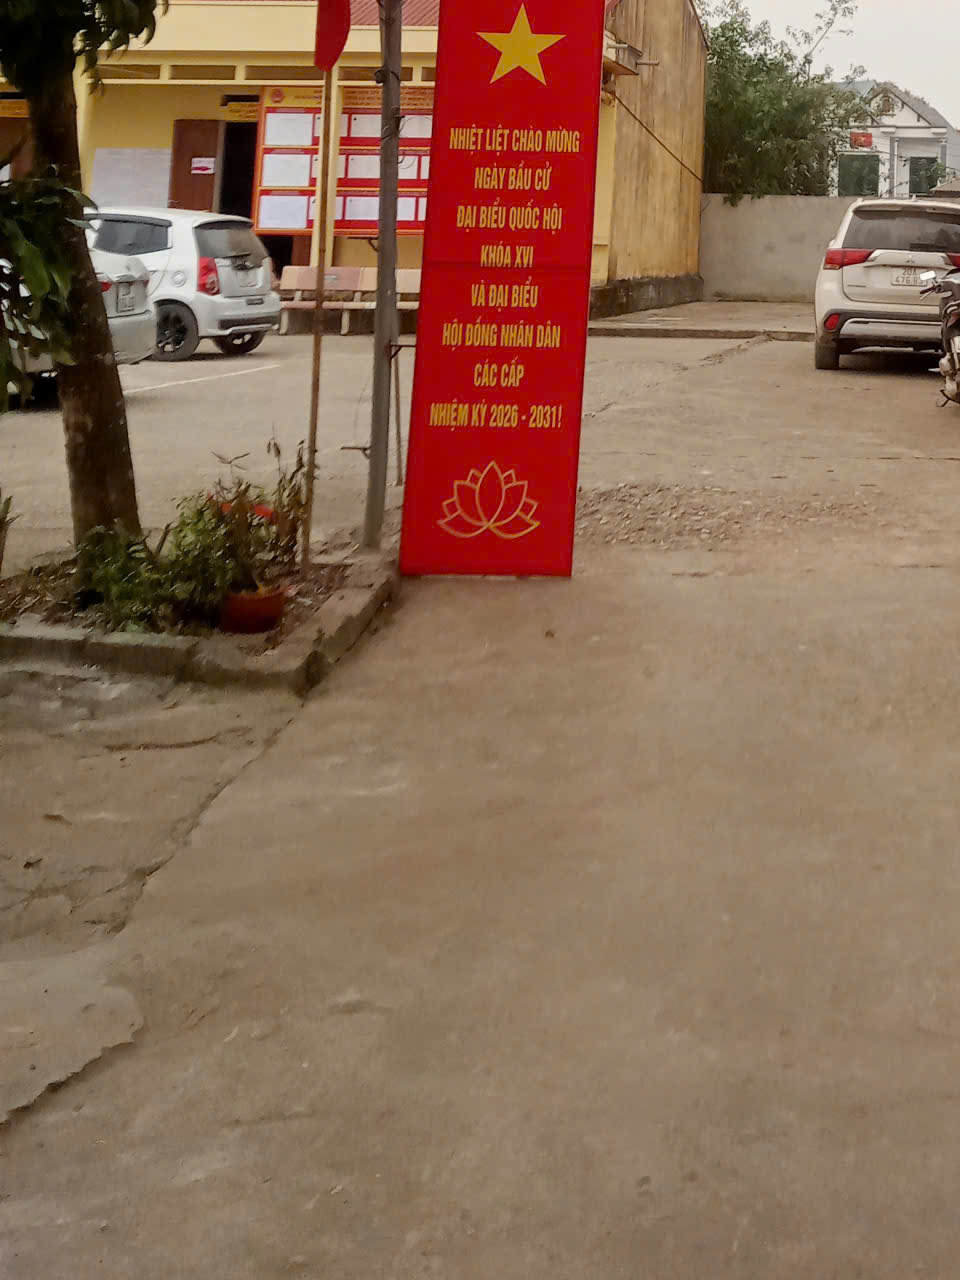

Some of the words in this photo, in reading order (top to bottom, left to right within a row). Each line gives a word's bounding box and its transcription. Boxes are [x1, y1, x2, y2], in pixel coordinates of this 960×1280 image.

[450, 125, 483, 153] NHIỆT
[486, 125, 509, 155] LIỆT
[511, 125, 543, 152] CHÀO
[545, 125, 580, 153] MỪNG
[475, 163, 506, 189] NGÀY
[535, 162, 552, 190] CỬ
[457, 206, 476, 232] ĐẠI
[480, 197, 506, 229] BIỂU
[509, 198, 540, 231] QUỐC
[543, 203, 562, 234] HỘI
[481, 241, 511, 267] KHÓA
[515, 246, 533, 267] XVI
[472, 280, 485, 306] VÀ
[489, 285, 508, 311] ĐẠI
[512, 277, 538, 307] BIỂU
[443, 320, 462, 350] HỘI
[501, 320, 533, 347] NHÂN
[536, 321, 560, 347] DÂN
[474, 360, 497, 386] CÁC
[501, 357, 524, 386] CẤP
[430, 400, 468, 430] NHIỆM
[489, 405, 518, 427] 2026
[529, 405, 561, 428] 2031!
